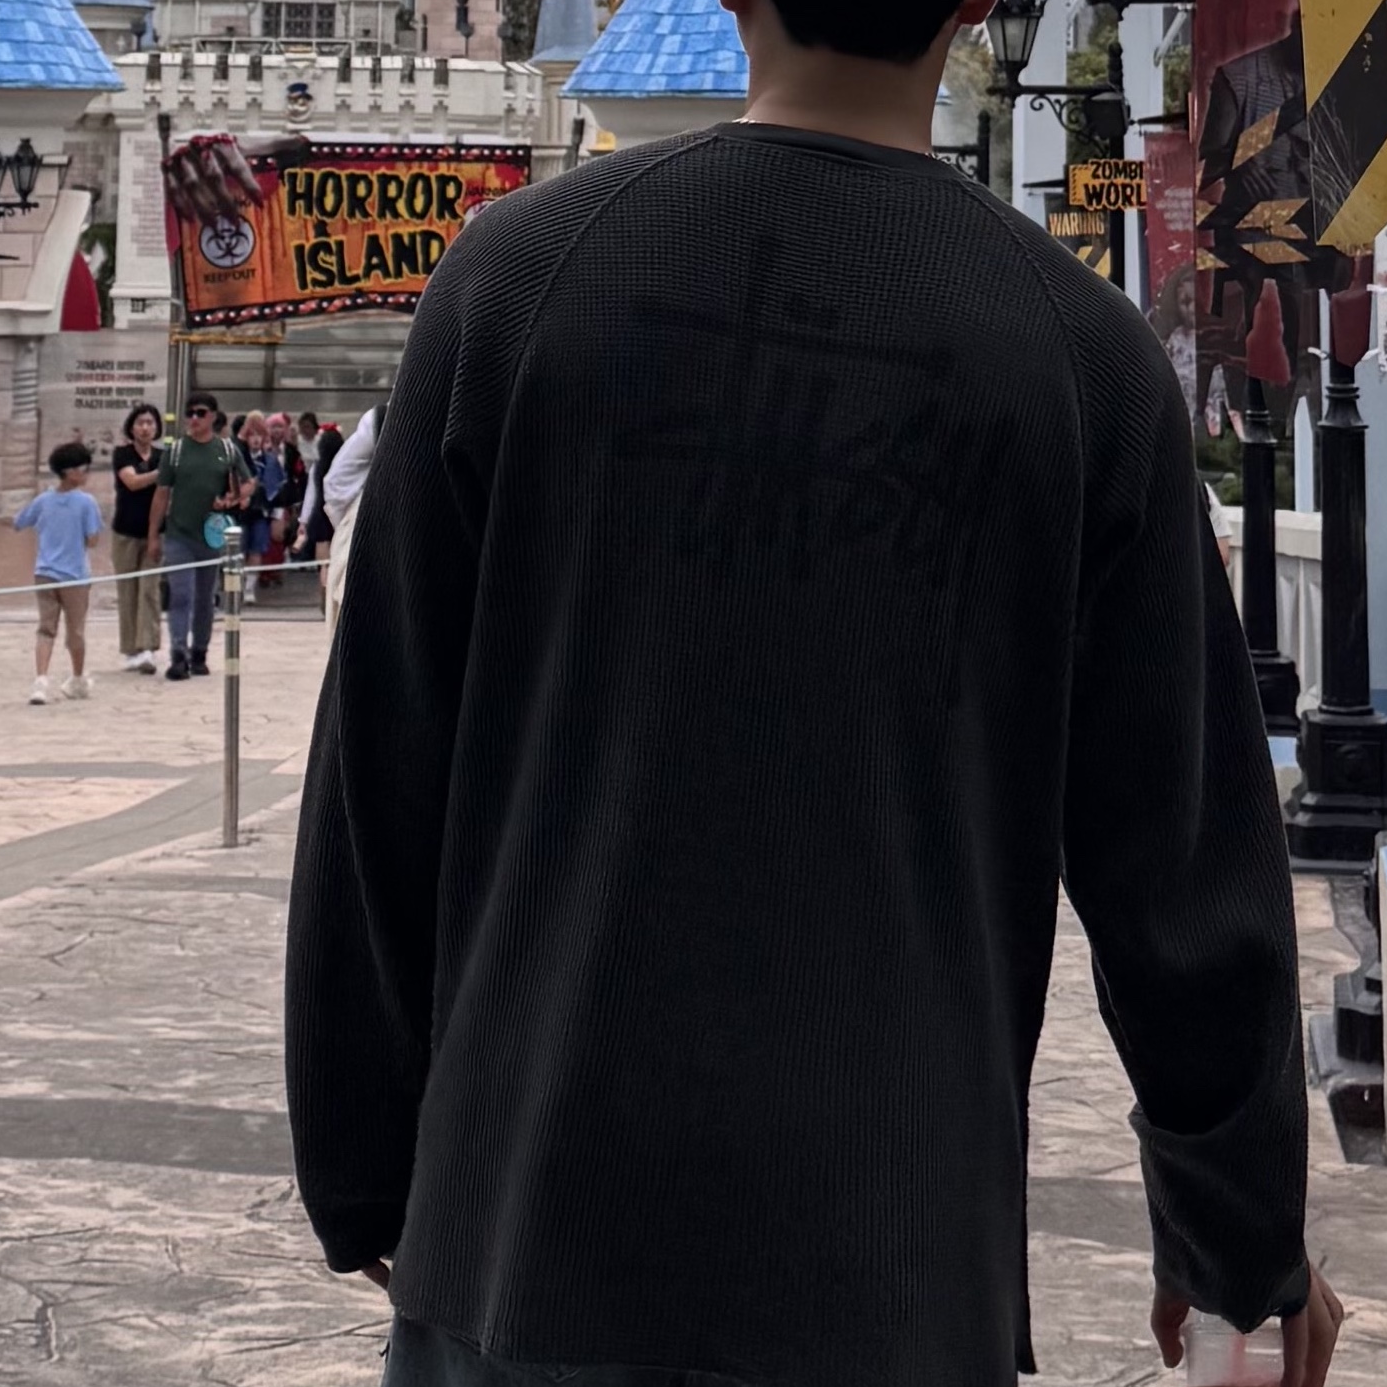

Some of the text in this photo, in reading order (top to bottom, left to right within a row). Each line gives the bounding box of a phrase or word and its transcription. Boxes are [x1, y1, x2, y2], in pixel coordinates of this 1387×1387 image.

[1091, 161, 1144, 180] ZOMBI
[285, 169, 464, 222] HORROR
[1084, 183, 1147, 208] WORL
[291, 230, 449, 292] ISLAND
